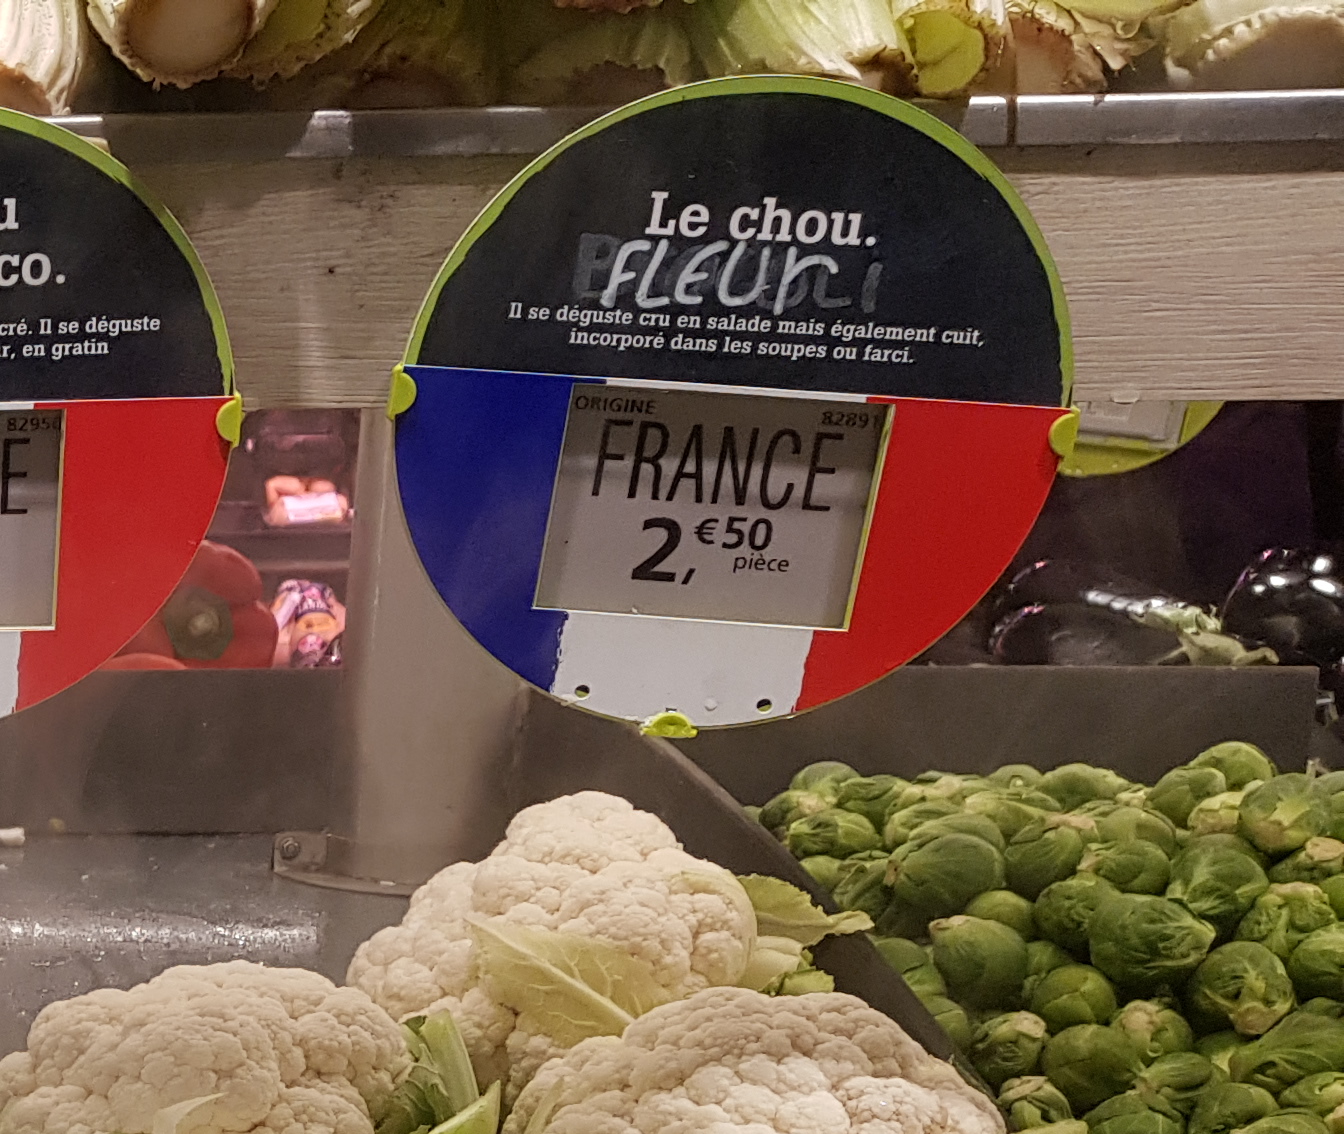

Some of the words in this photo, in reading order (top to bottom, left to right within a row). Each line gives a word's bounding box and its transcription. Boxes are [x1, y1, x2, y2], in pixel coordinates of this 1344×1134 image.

[645, 191, 709, 238] Le
[729, 197, 877, 247] chou.
[57, 320, 79, 334] se
[85, 315, 161, 336] déguste
[528, 307, 550, 320] se
[556, 303, 634, 328] déguste
[639, 310, 671, 326] cru
[677, 314, 701, 329] en
[707, 313, 771, 332] salade
[777, 318, 825, 336] mais
[831, 319, 936, 343] également
[941, 327, 984, 348] cuit,
[22, 342, 46, 357] en
[51, 339, 109, 359] gratin
[568, 329, 664, 350] incorporé
[670, 333, 717, 352] dans
[723, 336, 752, 353] les
[757, 340, 826, 360] soupes
[832, 345, 857, 359] ou
[862, 345, 915, 363] farci.
[575, 395, 656, 416] ORIGINE
[592, 418, 845, 512] FRANCE
[732, 552, 790, 573] pièce
